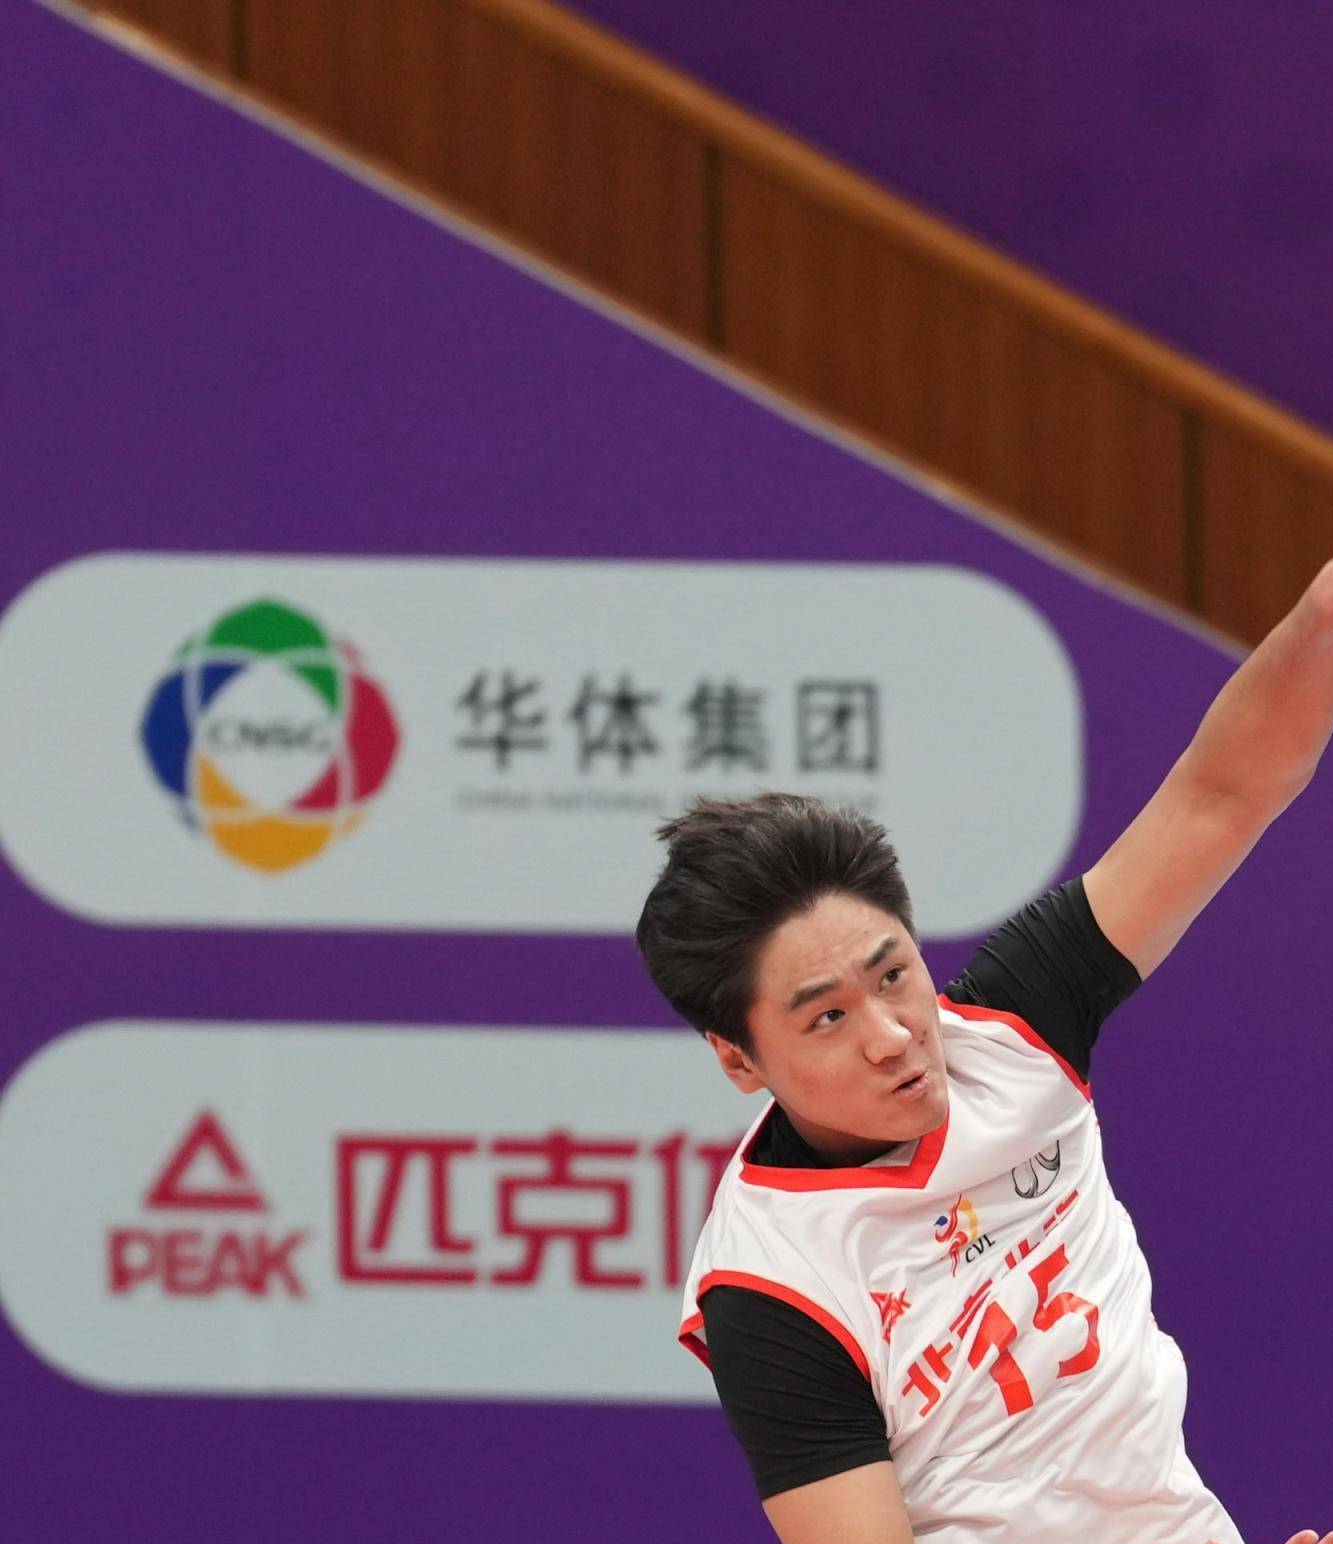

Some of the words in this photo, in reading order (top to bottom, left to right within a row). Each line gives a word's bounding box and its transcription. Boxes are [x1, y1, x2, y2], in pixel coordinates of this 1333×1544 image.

[455, 670, 880, 775] 华体集团
[108, 1227, 309, 1298] PEAK
[965, 1234, 996, 1263] CVL
